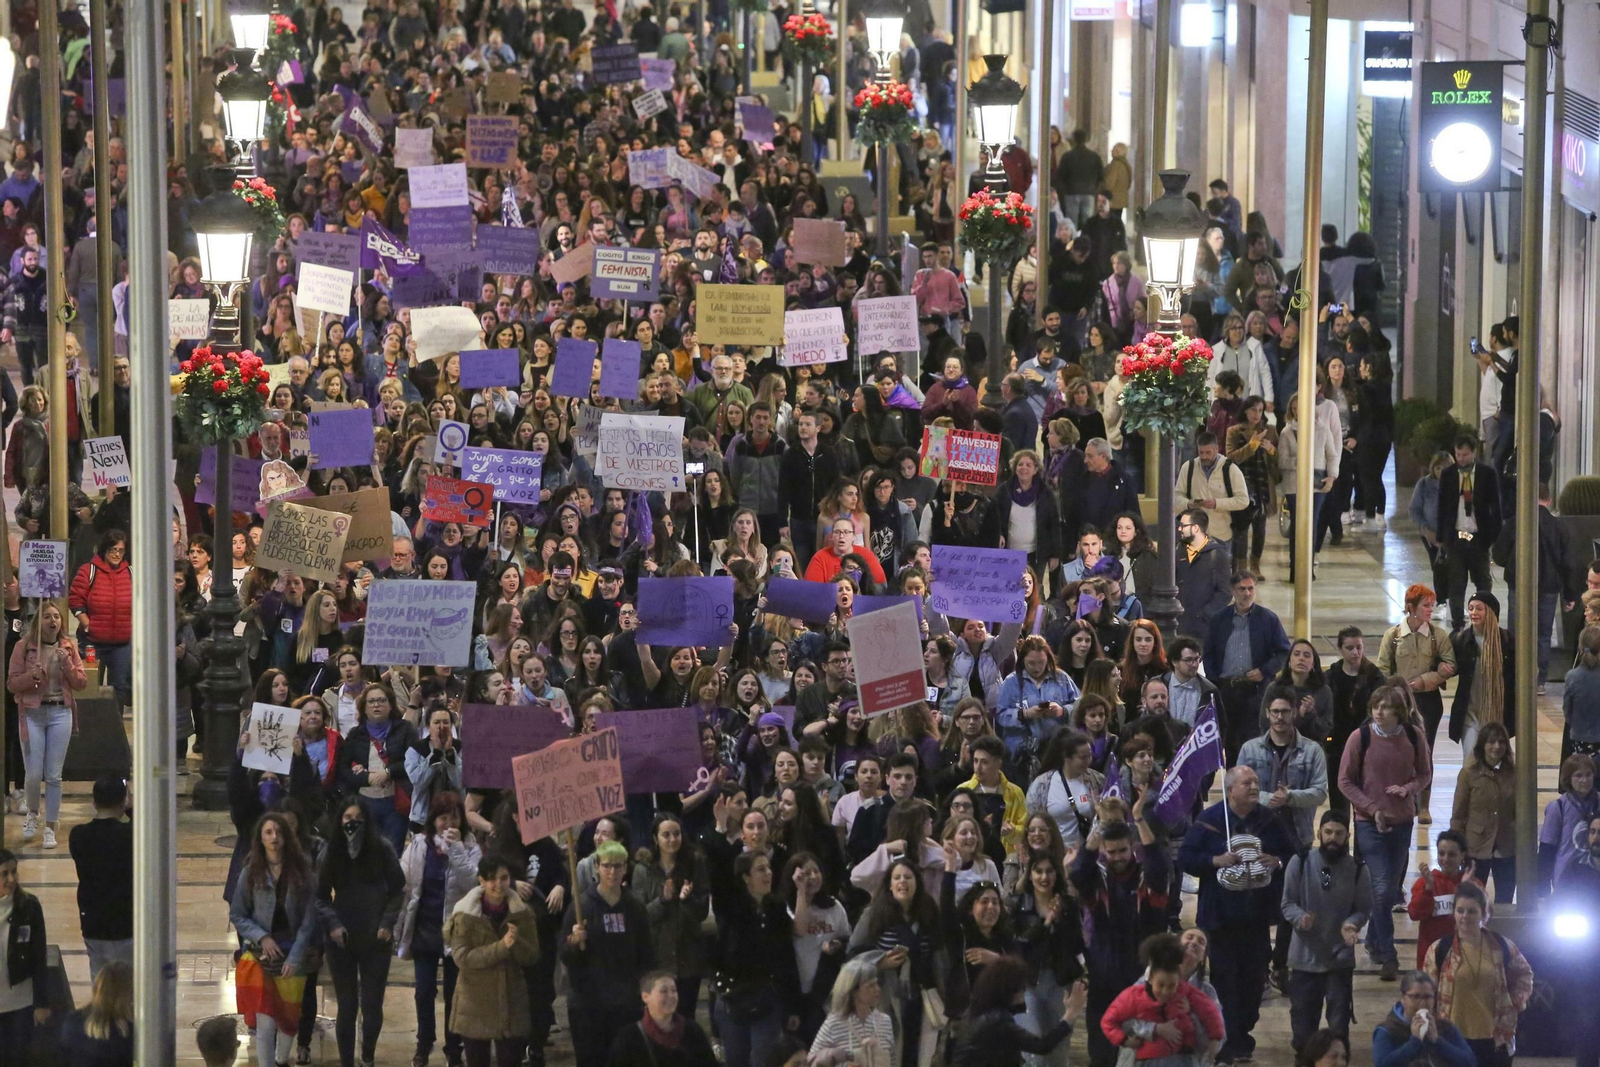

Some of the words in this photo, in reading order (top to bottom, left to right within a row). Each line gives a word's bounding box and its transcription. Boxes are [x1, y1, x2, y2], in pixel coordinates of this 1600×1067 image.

[1432, 91, 1491, 104] ROLEX
[598, 252, 623, 260] COGITO
[631, 254, 651, 263] ERGO
[602, 264, 648, 278] FEMINISTA
[617, 284, 632, 292] SUM
[859, 303, 896, 311] TRATARON
[901, 302, 911, 310] DE
[861, 324, 869, 332] NO
[899, 322, 912, 330] QUE
[831, 337, 844, 346] EL
[793, 349, 826, 364] MIEDO
[600, 429, 642, 443] ESTAMOS
[952, 430, 973, 438] POR
[980, 433, 999, 441] LAS
[952, 436, 998, 450] TRAVESTIS
[85, 440, 122, 455] Times
[601, 441, 621, 455] LOS
[626, 443, 676, 458] OVARIOS
[959, 444, 998, 456] MUJERES
[91, 454, 125, 469] New
[469, 452, 504, 463] JUNTAS
[510, 457, 542, 467] SOMOS
[606, 457, 621, 470] DE
[627, 459, 679, 474] VUESTROS
[951, 451, 996, 466] TRANS
[498, 466, 533, 475] GRITO
[948, 461, 996, 474] ASESINADAS
[93, 471, 130, 487] Woman
[615, 473, 666, 490] COJONES
[511, 490, 534, 500] VOZ
[275, 504, 307, 523] SOMOS
[309, 512, 328, 527] LAS
[301, 526, 312, 539] DE
[316, 529, 333, 543] LAS
[267, 531, 298, 549] BRUJAS
[298, 539, 315, 553] QUE
[317, 543, 329, 556] NO
[345, 536, 384, 551] ARCADO
[304, 553, 336, 573] QUEMAR
[945, 579, 966, 591] FLOR
[370, 584, 396, 603] NO
[398, 584, 432, 604] HAY
[432, 584, 475, 601] MIEDO
[369, 606, 394, 620] HOY
[366, 622, 386, 637] SE
[387, 624, 421, 638] QUEDA
[366, 638, 426, 650] BORRACHA
[581, 730, 618, 762] GRITO
[521, 782, 546, 808] DE
[525, 805, 541, 822] NO
[596, 784, 623, 812] VOZ
